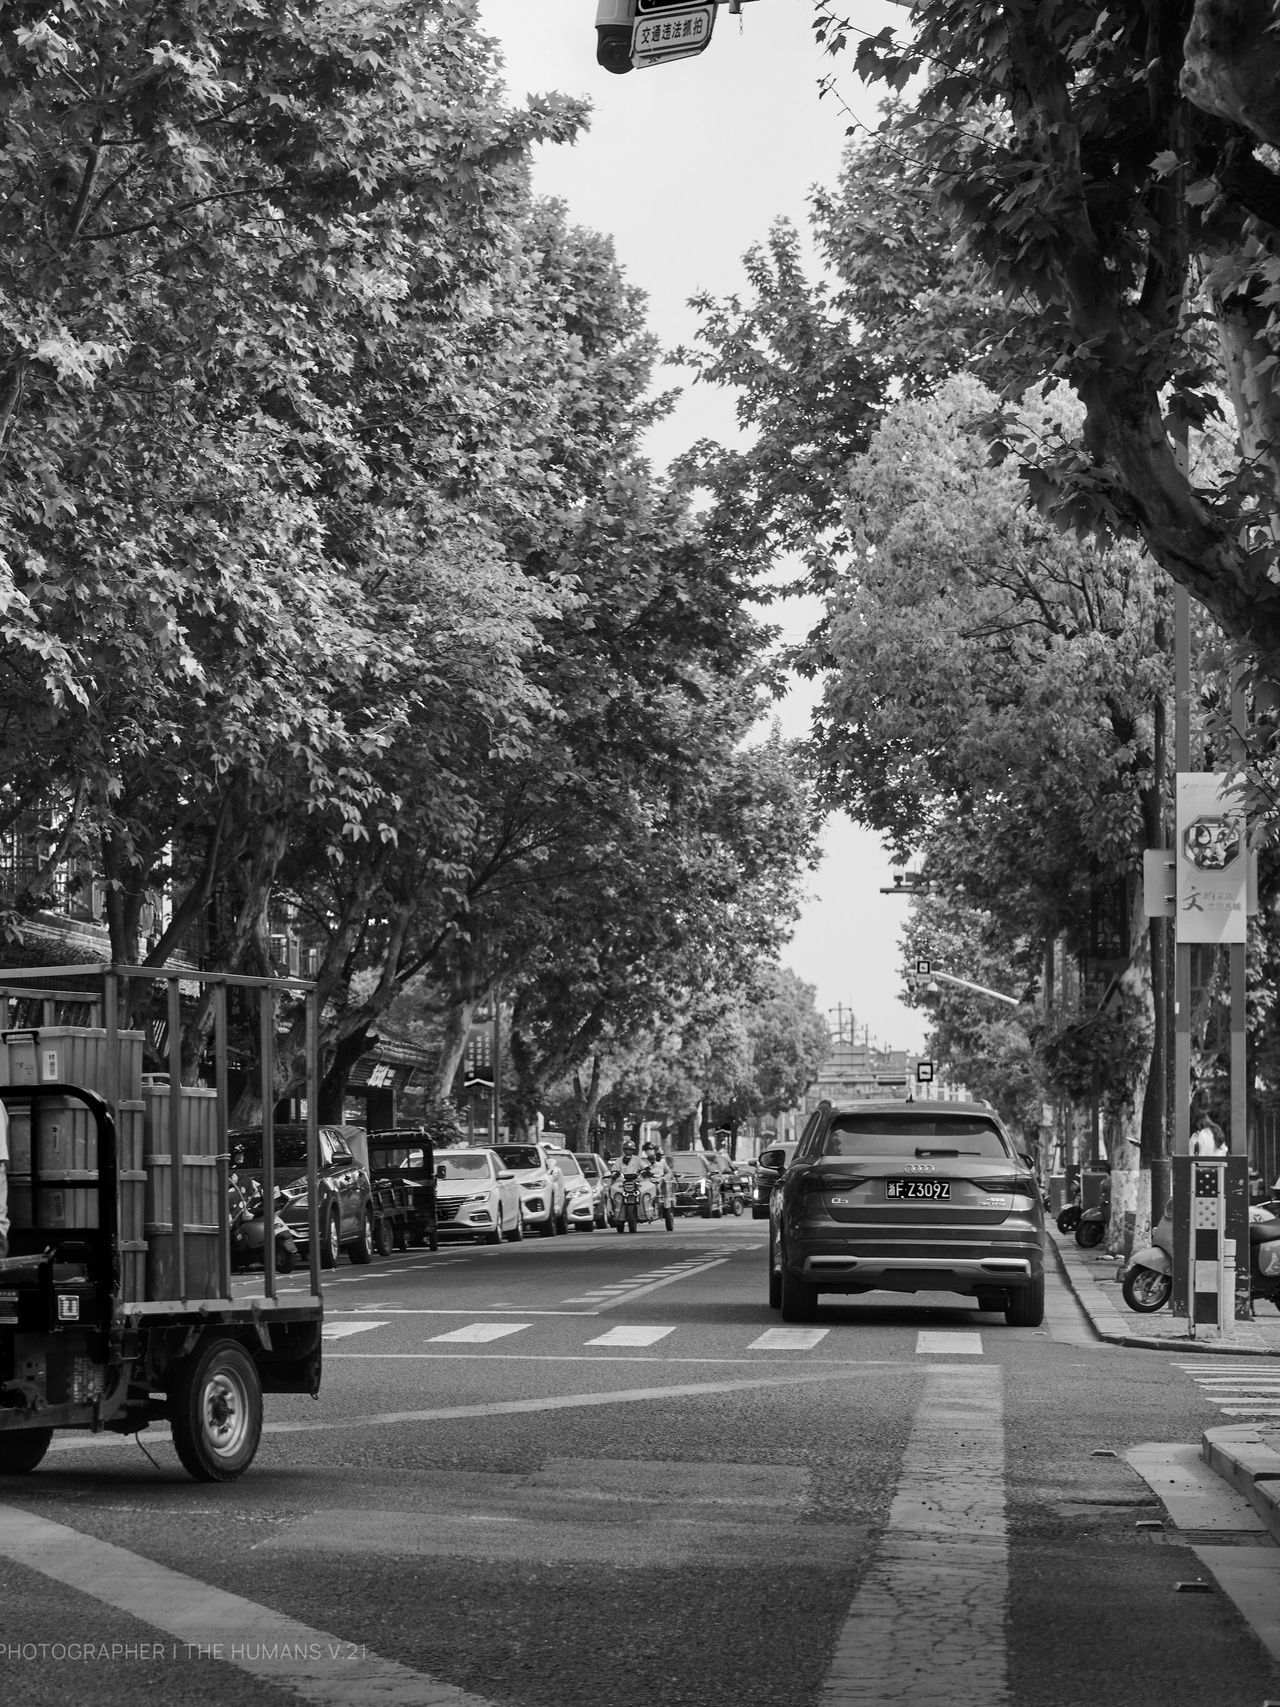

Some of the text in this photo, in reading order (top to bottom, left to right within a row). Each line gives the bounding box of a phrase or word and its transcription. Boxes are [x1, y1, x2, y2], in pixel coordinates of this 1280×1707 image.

[641, 17, 704, 44] 交通违法抓拍
